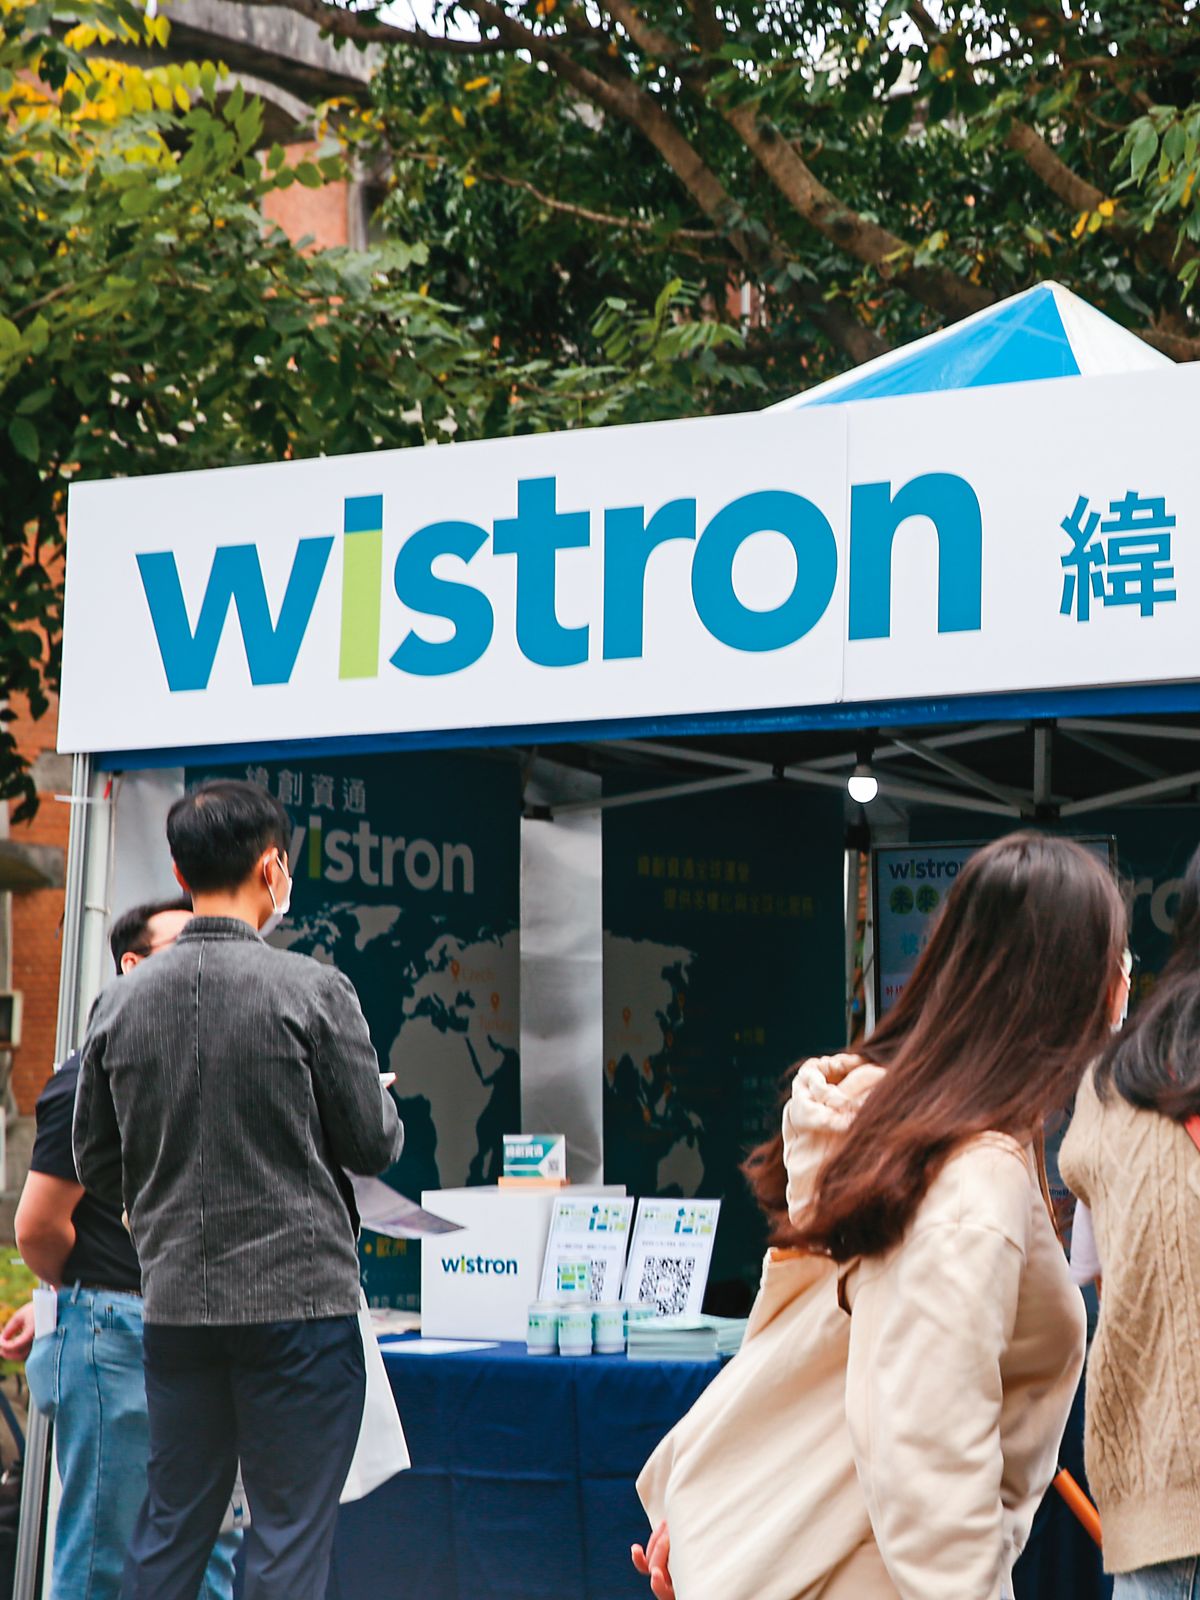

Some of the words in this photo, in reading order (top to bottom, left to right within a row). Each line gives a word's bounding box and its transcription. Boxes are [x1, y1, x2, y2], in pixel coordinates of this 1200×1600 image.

[135, 472, 982, 692] wistron
[888, 858, 965, 879] wistro
[441, 1254, 518, 1274] wistron
